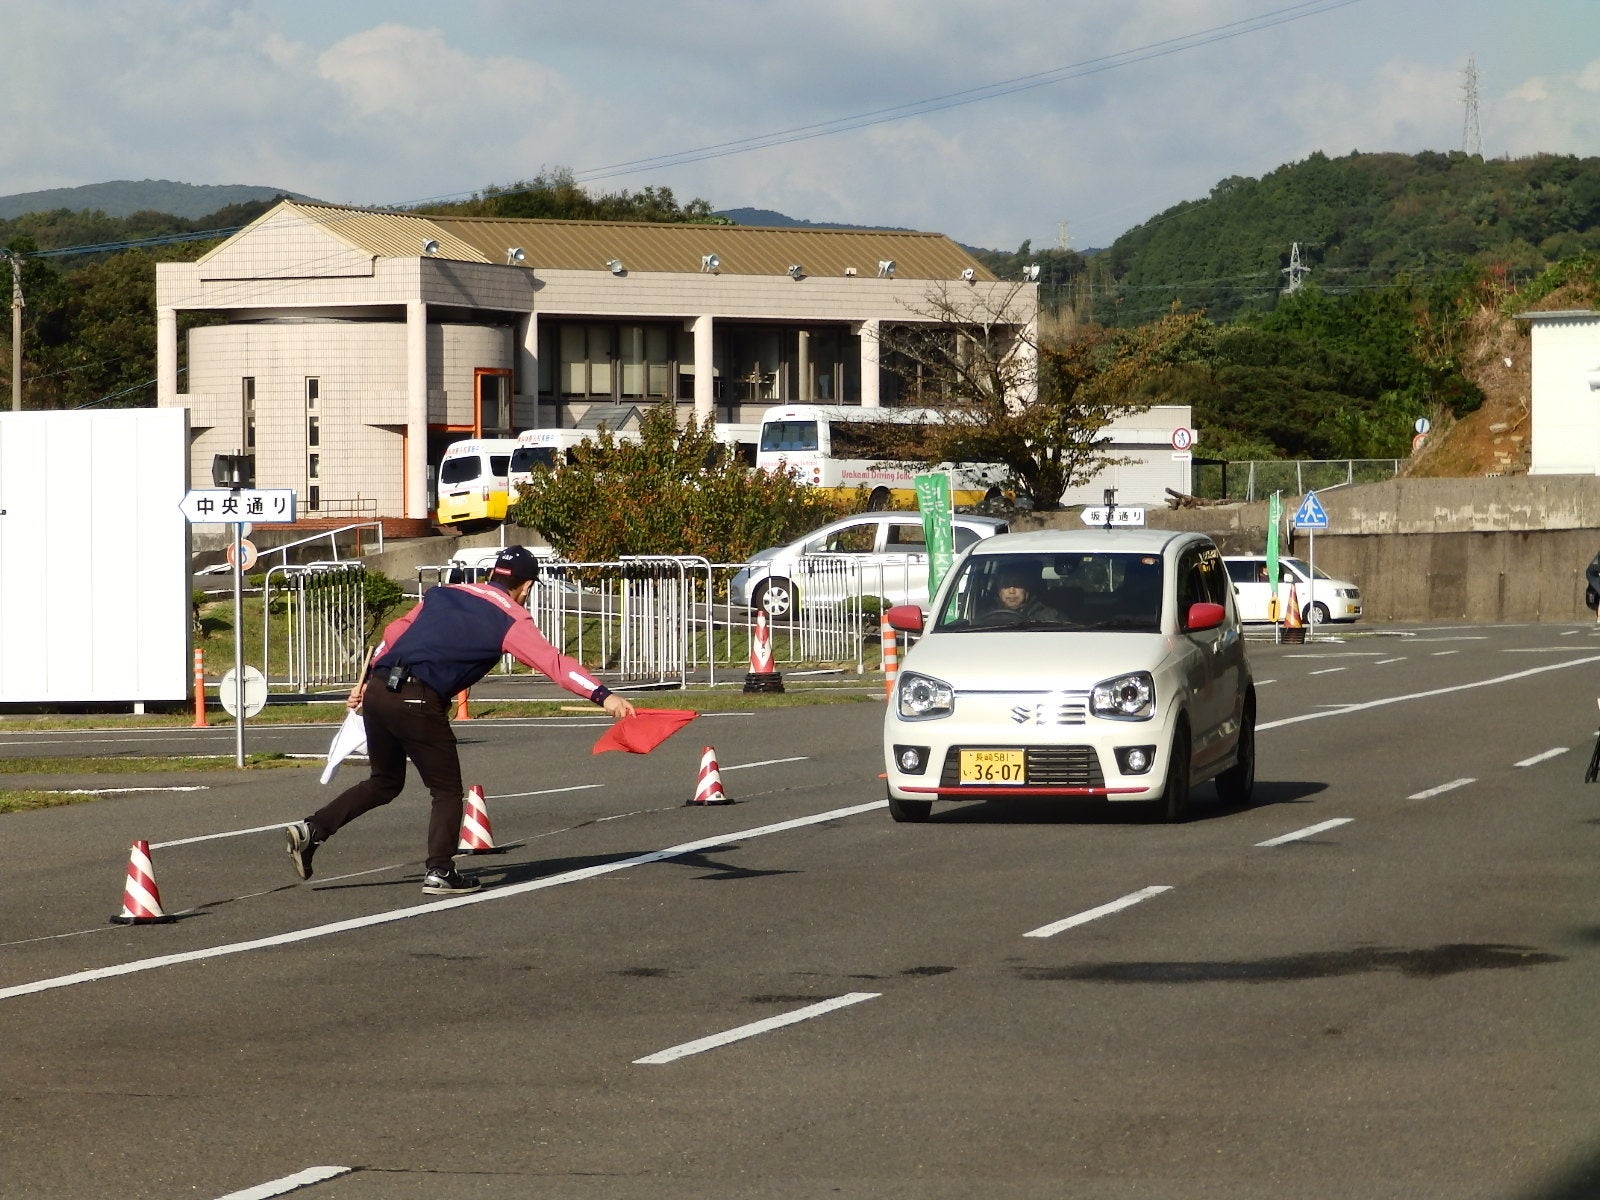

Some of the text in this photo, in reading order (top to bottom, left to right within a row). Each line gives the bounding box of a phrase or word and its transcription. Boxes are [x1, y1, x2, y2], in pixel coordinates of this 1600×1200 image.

[841, 470, 914, 482] Urakami Driving Scho
[197, 497, 286, 515] 中央通り
[1271, 600, 1277, 619] 7
[974, 764, 1021, 781] 36-07
